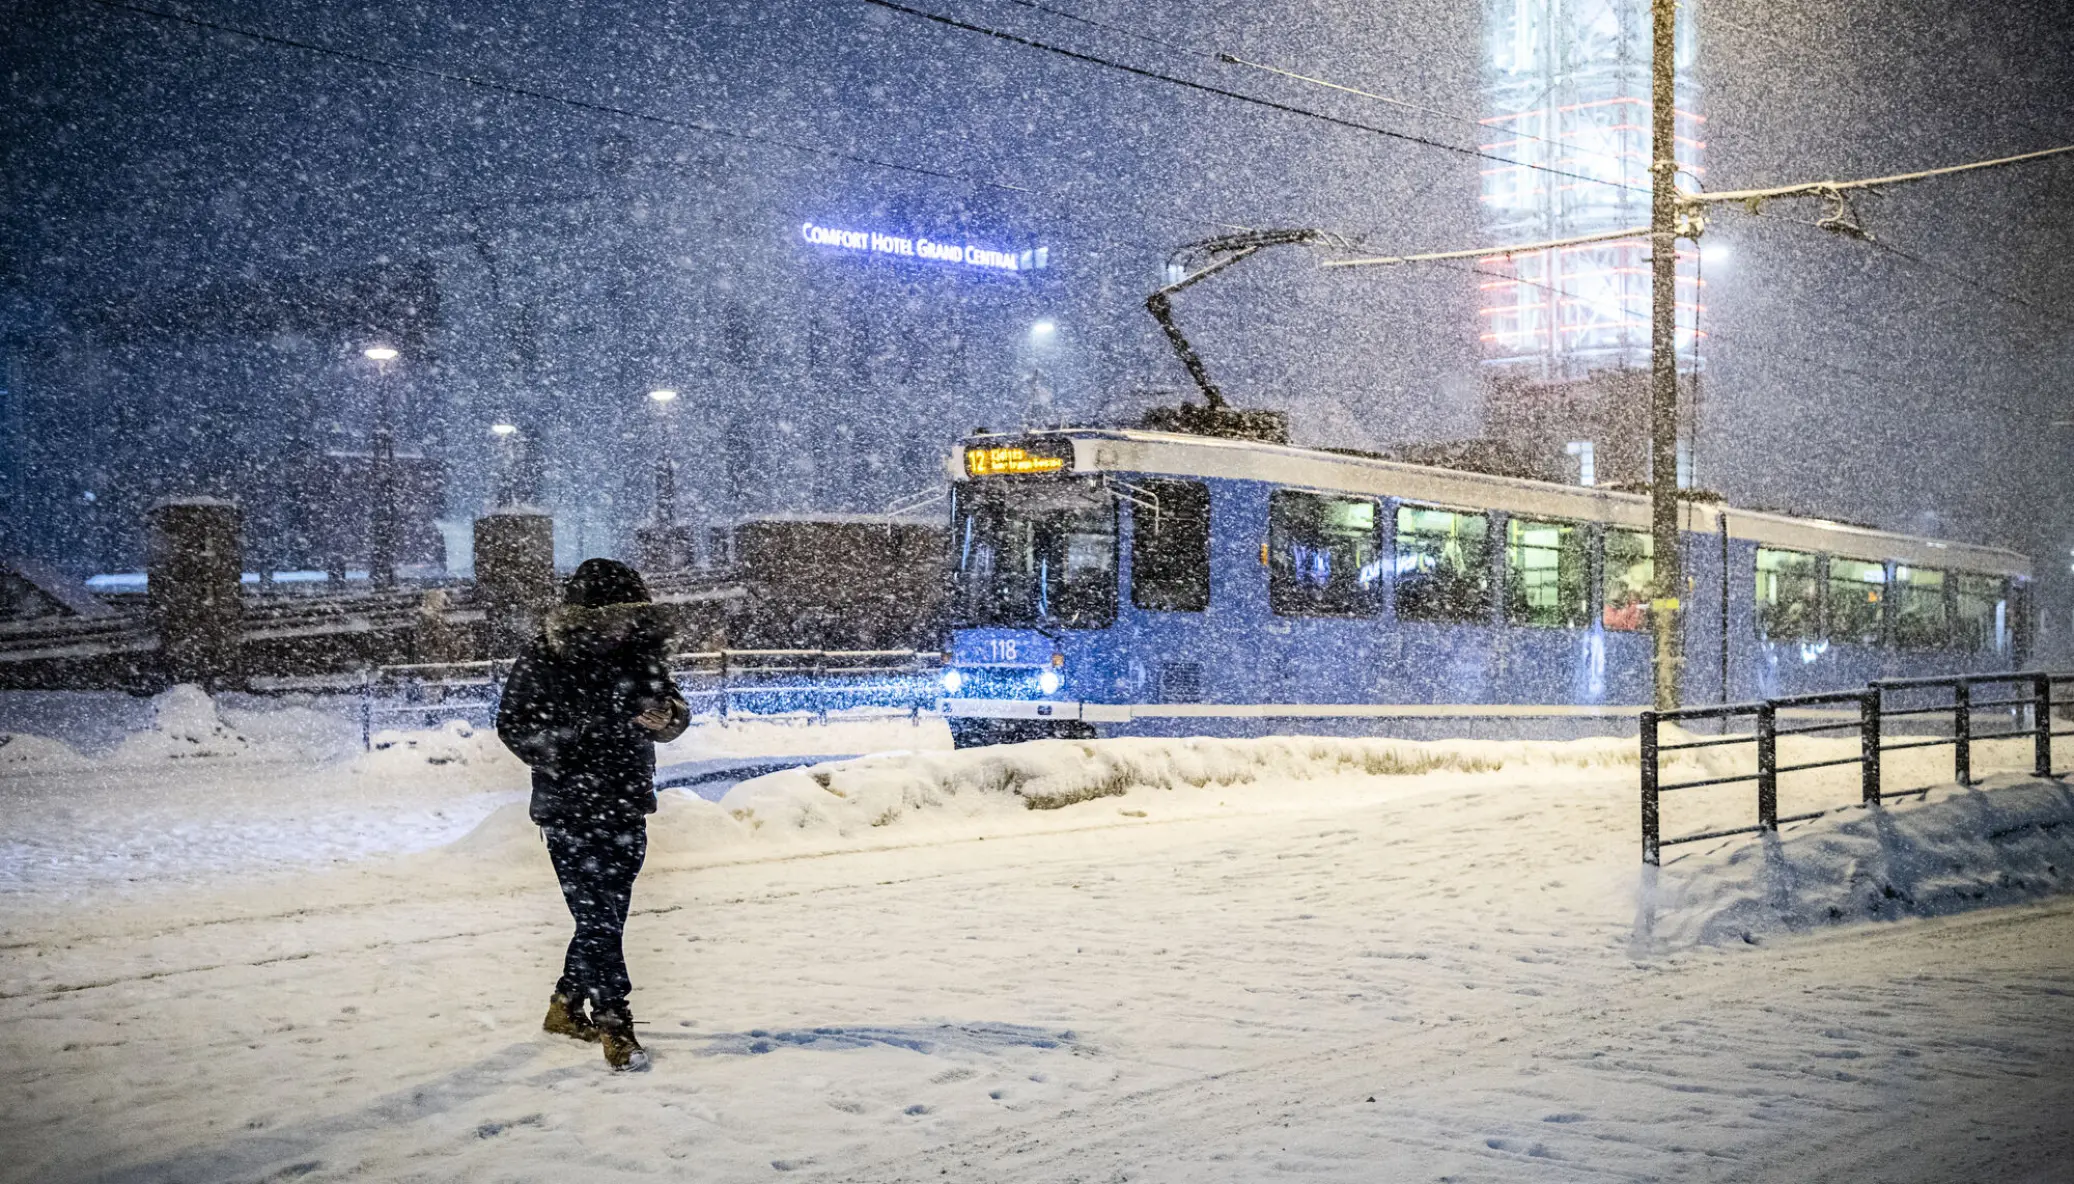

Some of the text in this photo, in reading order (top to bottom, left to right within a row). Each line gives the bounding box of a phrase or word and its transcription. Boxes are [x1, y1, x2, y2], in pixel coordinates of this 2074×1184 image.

[802, 222, 1018, 270] COMFORT HOTEL GRAND CENTRAL
[968, 451, 986, 472] 12
[990, 639, 1017, 660] 118
